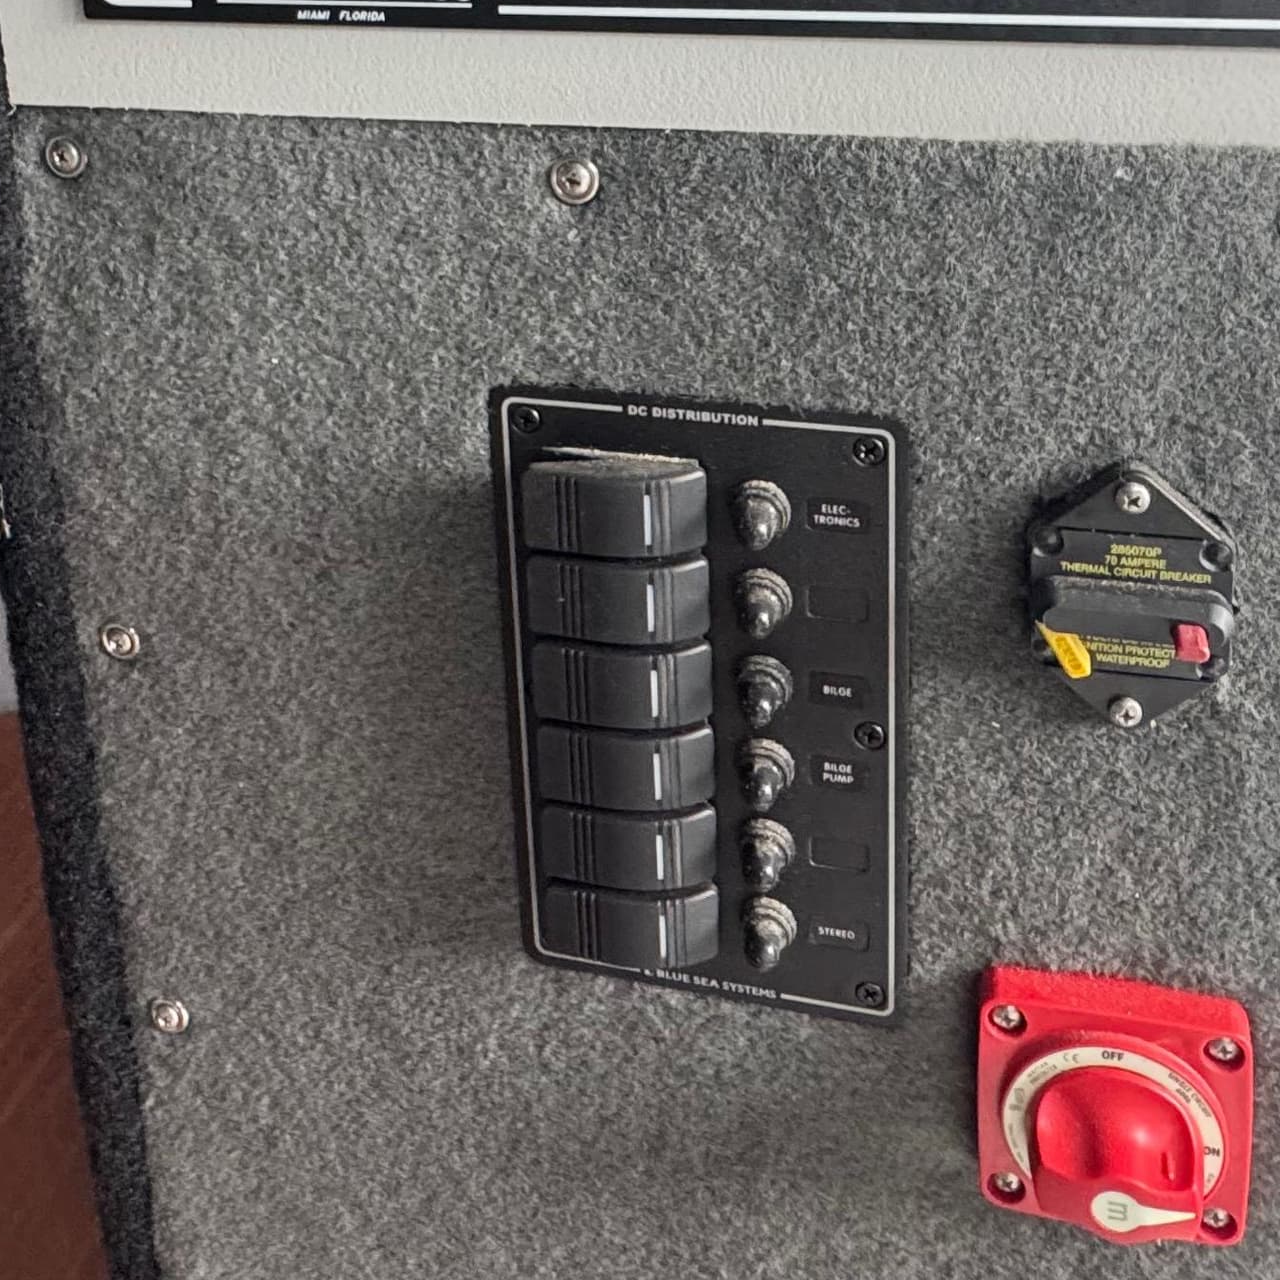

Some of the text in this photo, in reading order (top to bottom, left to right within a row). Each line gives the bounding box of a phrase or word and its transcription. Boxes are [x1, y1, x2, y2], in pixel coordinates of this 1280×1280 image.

[297, 9, 386, 22] MIAMI FLORIDA
[627, 404, 759, 426] DC DISTRIBUTION
[821, 503, 851, 516] ELEC-
[813, 514, 860, 528] TRONICS
[1105, 554, 1167, 570] 70 AMPERE
[1060, 560, 1212, 585] THERMAL CIRCUIT BREAKER
[1086, 640, 1123, 654] NITION
[1125, 644, 1176, 660] PROTECT
[1096, 652, 1170, 669] WATERPROOF
[823, 772, 854, 784] PUMP
[818, 925, 856, 940] STEREO
[656, 968, 776, 999] BLUE SEA SYSTEMS
[1101, 1050, 1125, 1061] OFF
